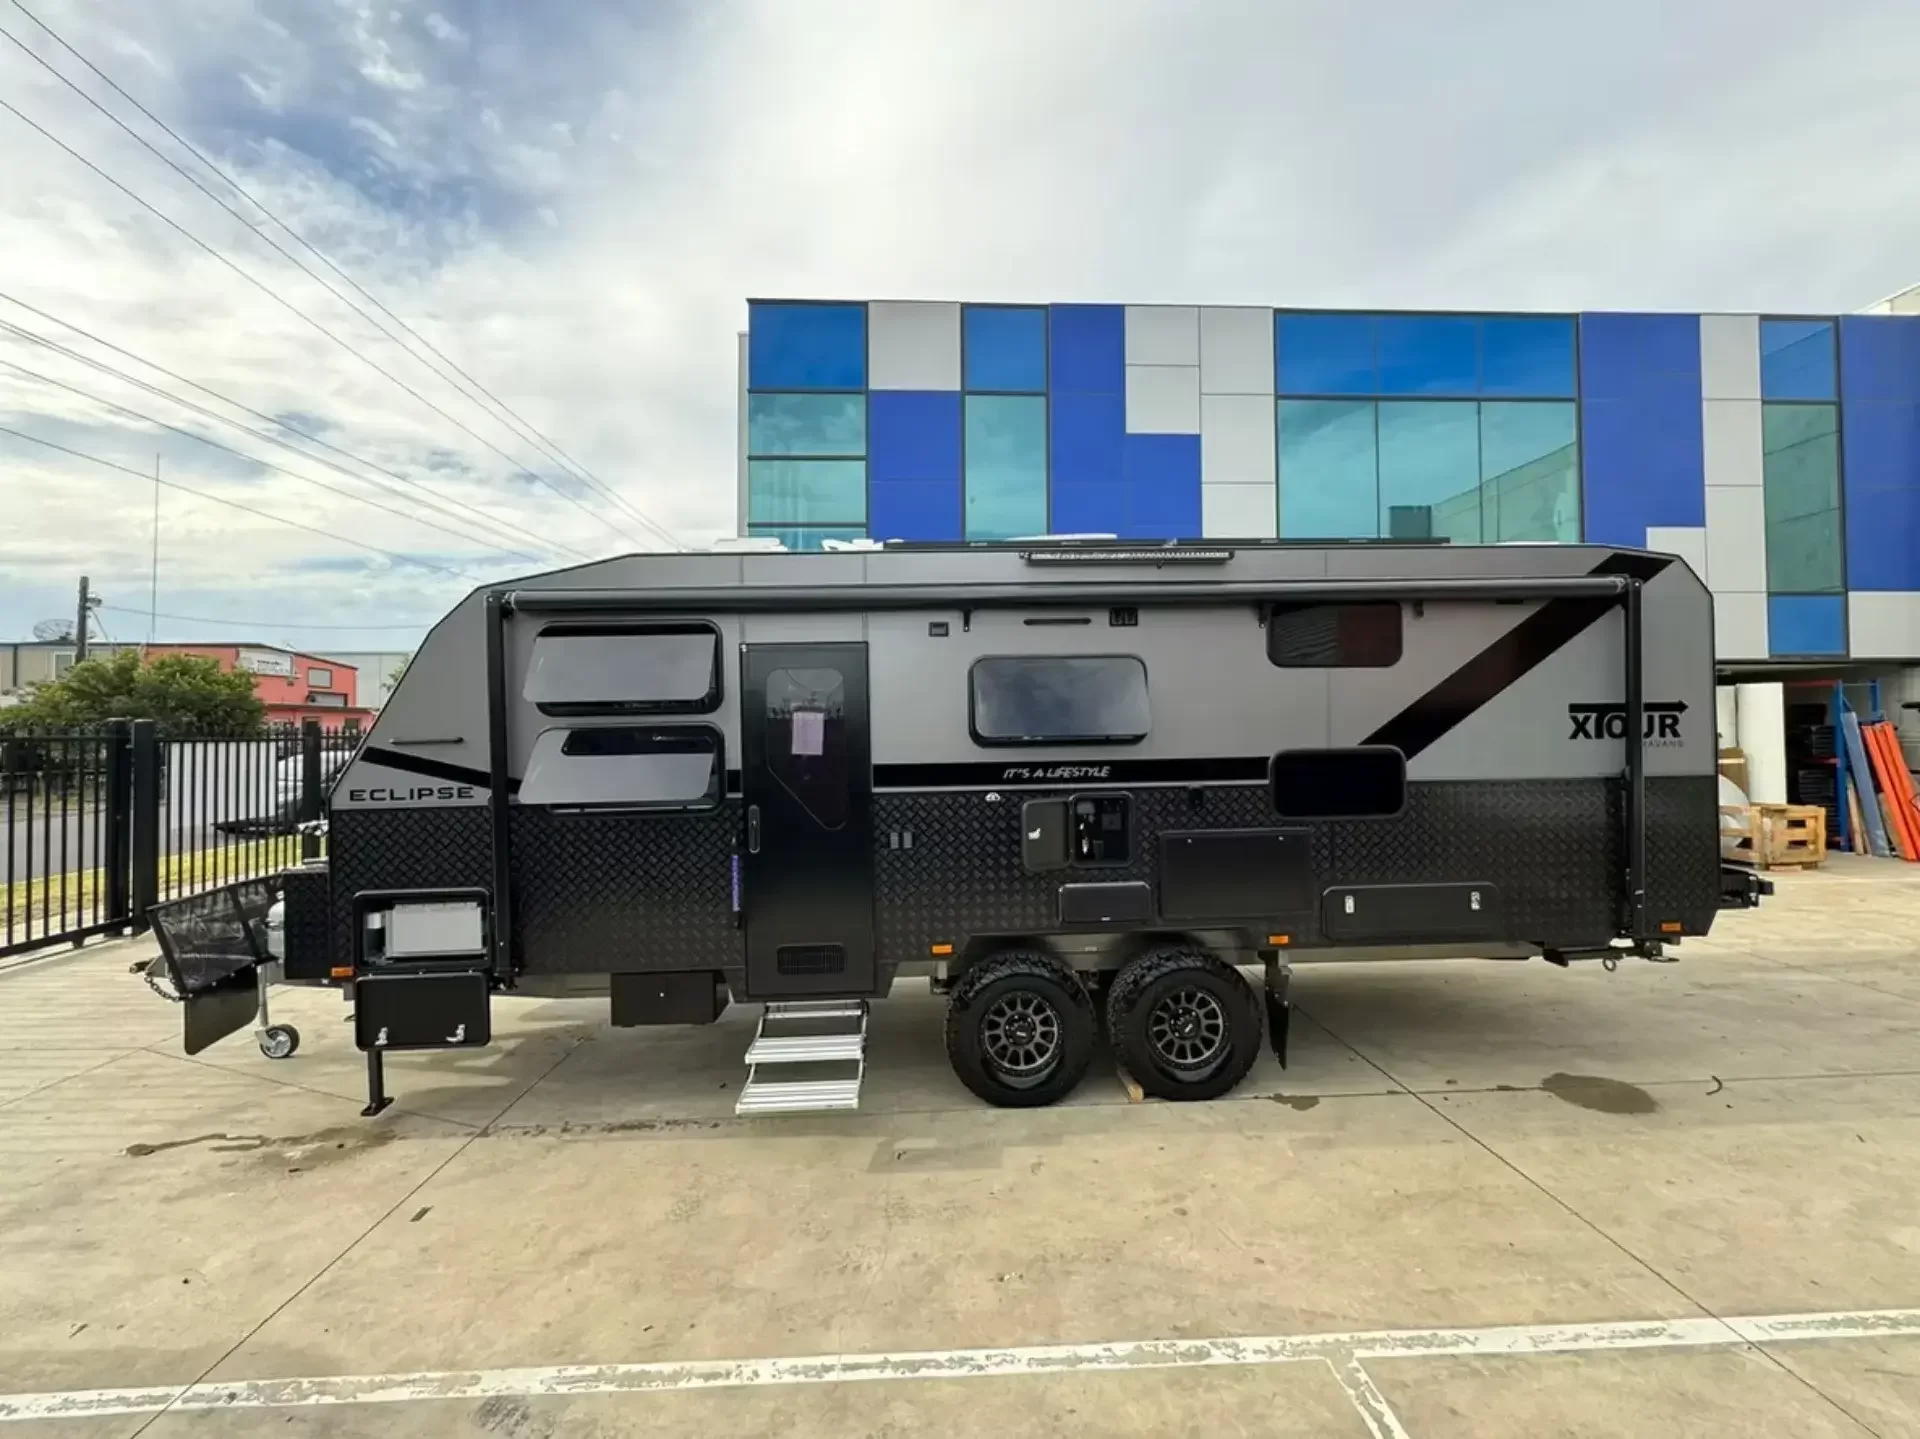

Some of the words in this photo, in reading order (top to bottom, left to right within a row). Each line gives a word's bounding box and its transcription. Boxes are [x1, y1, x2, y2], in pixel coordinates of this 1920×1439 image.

[1003, 768, 1030, 779] IT'S
[1033, 768, 1045, 778] A
[1046, 766, 1110, 778] LIFESTYLE
[349, 786, 475, 801] ECLIPSE
